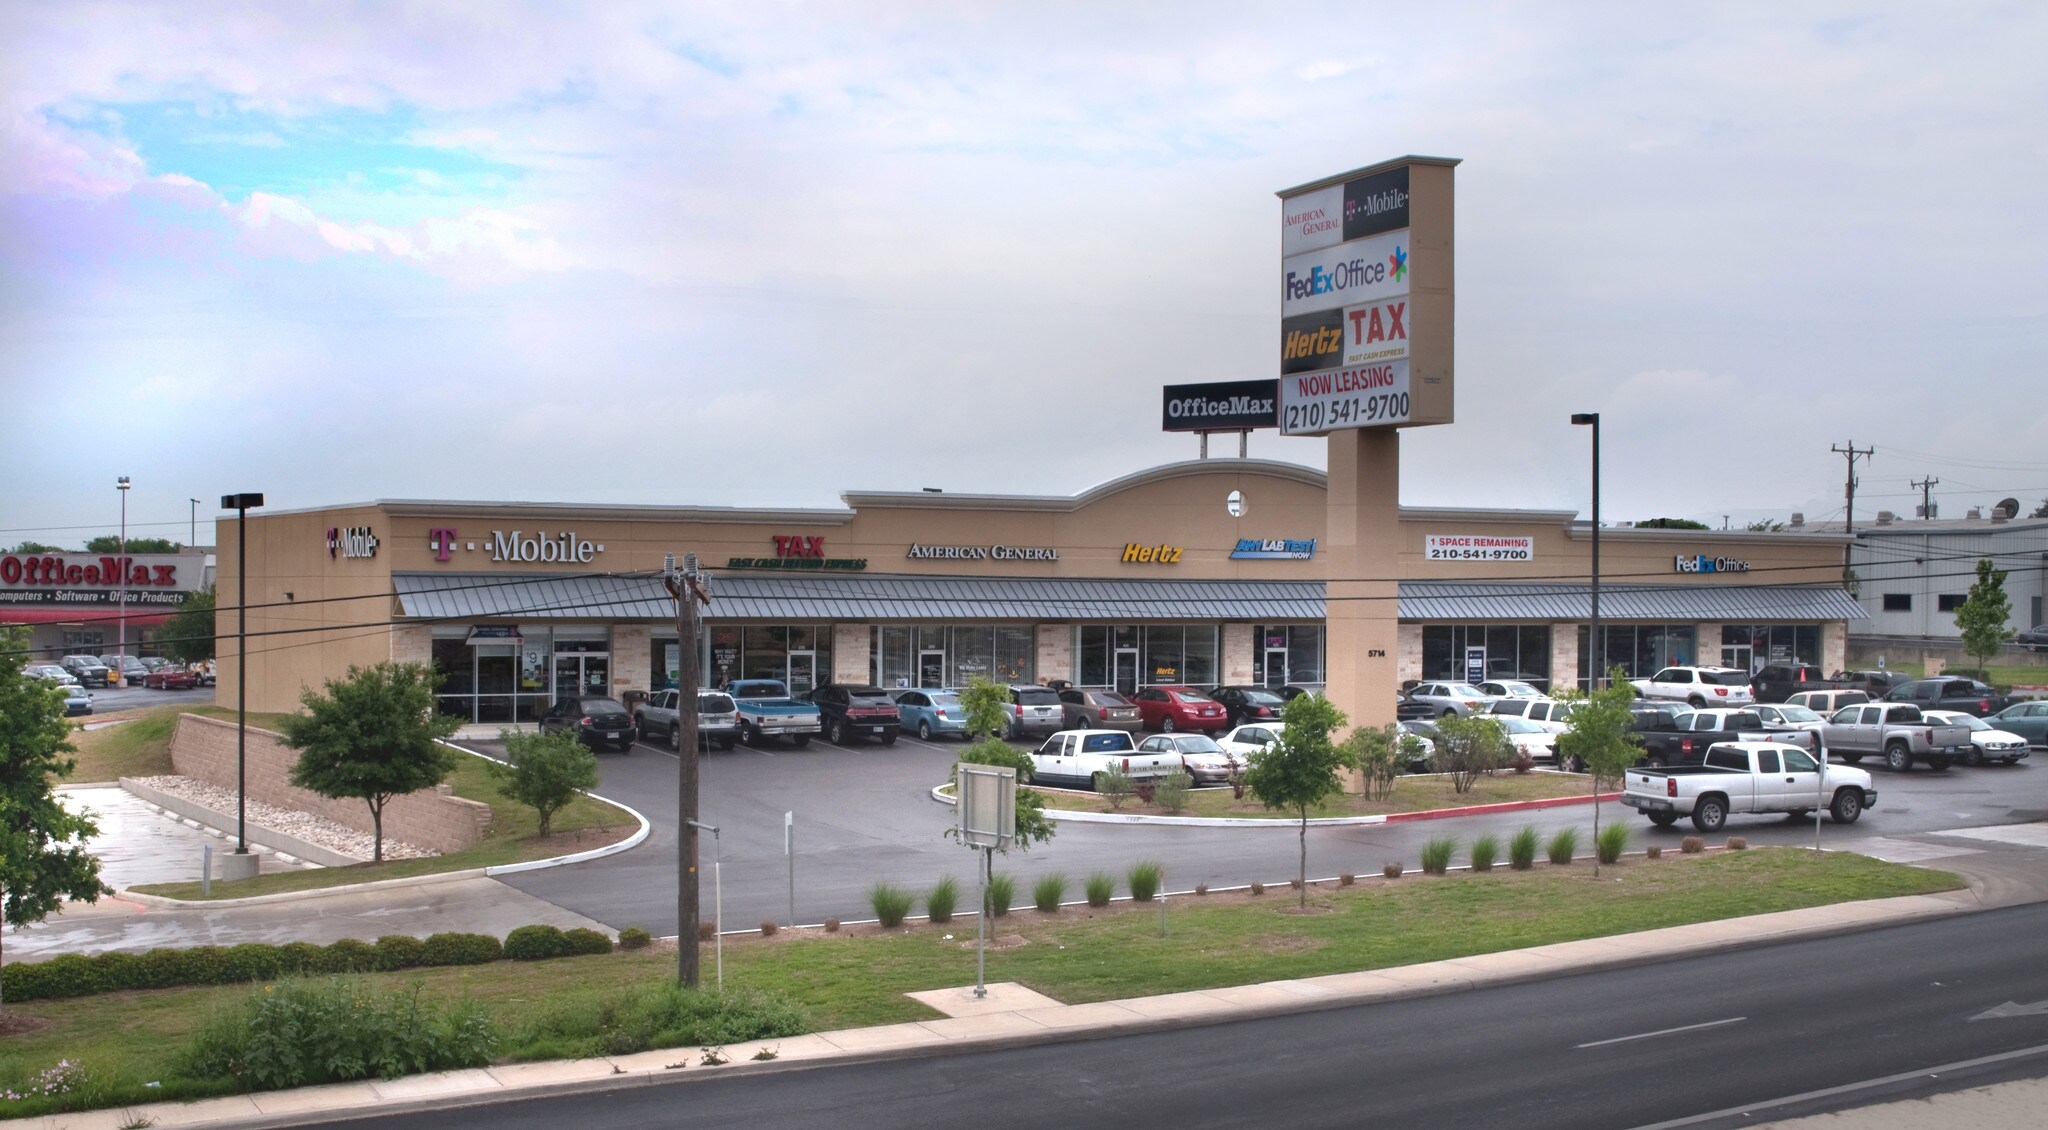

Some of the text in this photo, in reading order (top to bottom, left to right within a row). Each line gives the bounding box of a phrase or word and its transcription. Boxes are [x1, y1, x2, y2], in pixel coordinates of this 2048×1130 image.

[1284, 208, 1326, 227] AMERICAN
[1302, 218, 1340, 236] GENERAL
[1348, 301, 1407, 346] TAX
[1283, 325, 1342, 361] Hertz
[1348, 354, 1363, 363] FAST
[1363, 352, 1379, 360] CASH
[1298, 365, 1394, 398] NOW LEASING
[1168, 396, 1273, 418] OfficeMax
[1283, 391, 1410, 434] (210) 541-9700
[772, 535, 825, 558] TAX
[907, 543, 1060, 561] AMERICAN GENERAL
[1430, 538, 1528, 548] 1 SPACE REMAINING
[1121, 543, 1184, 563] Hertz
[1292, 552, 1311, 560] NOW
[1431, 549, 1528, 559] 210-541-9700
[0, 556, 177, 586] OfficeMax
[0, 590, 184, 603] omputers Software Ofice Products
[1368, 650, 1386, 658] 5714
[1155, 667, 1176, 675] Hertz
